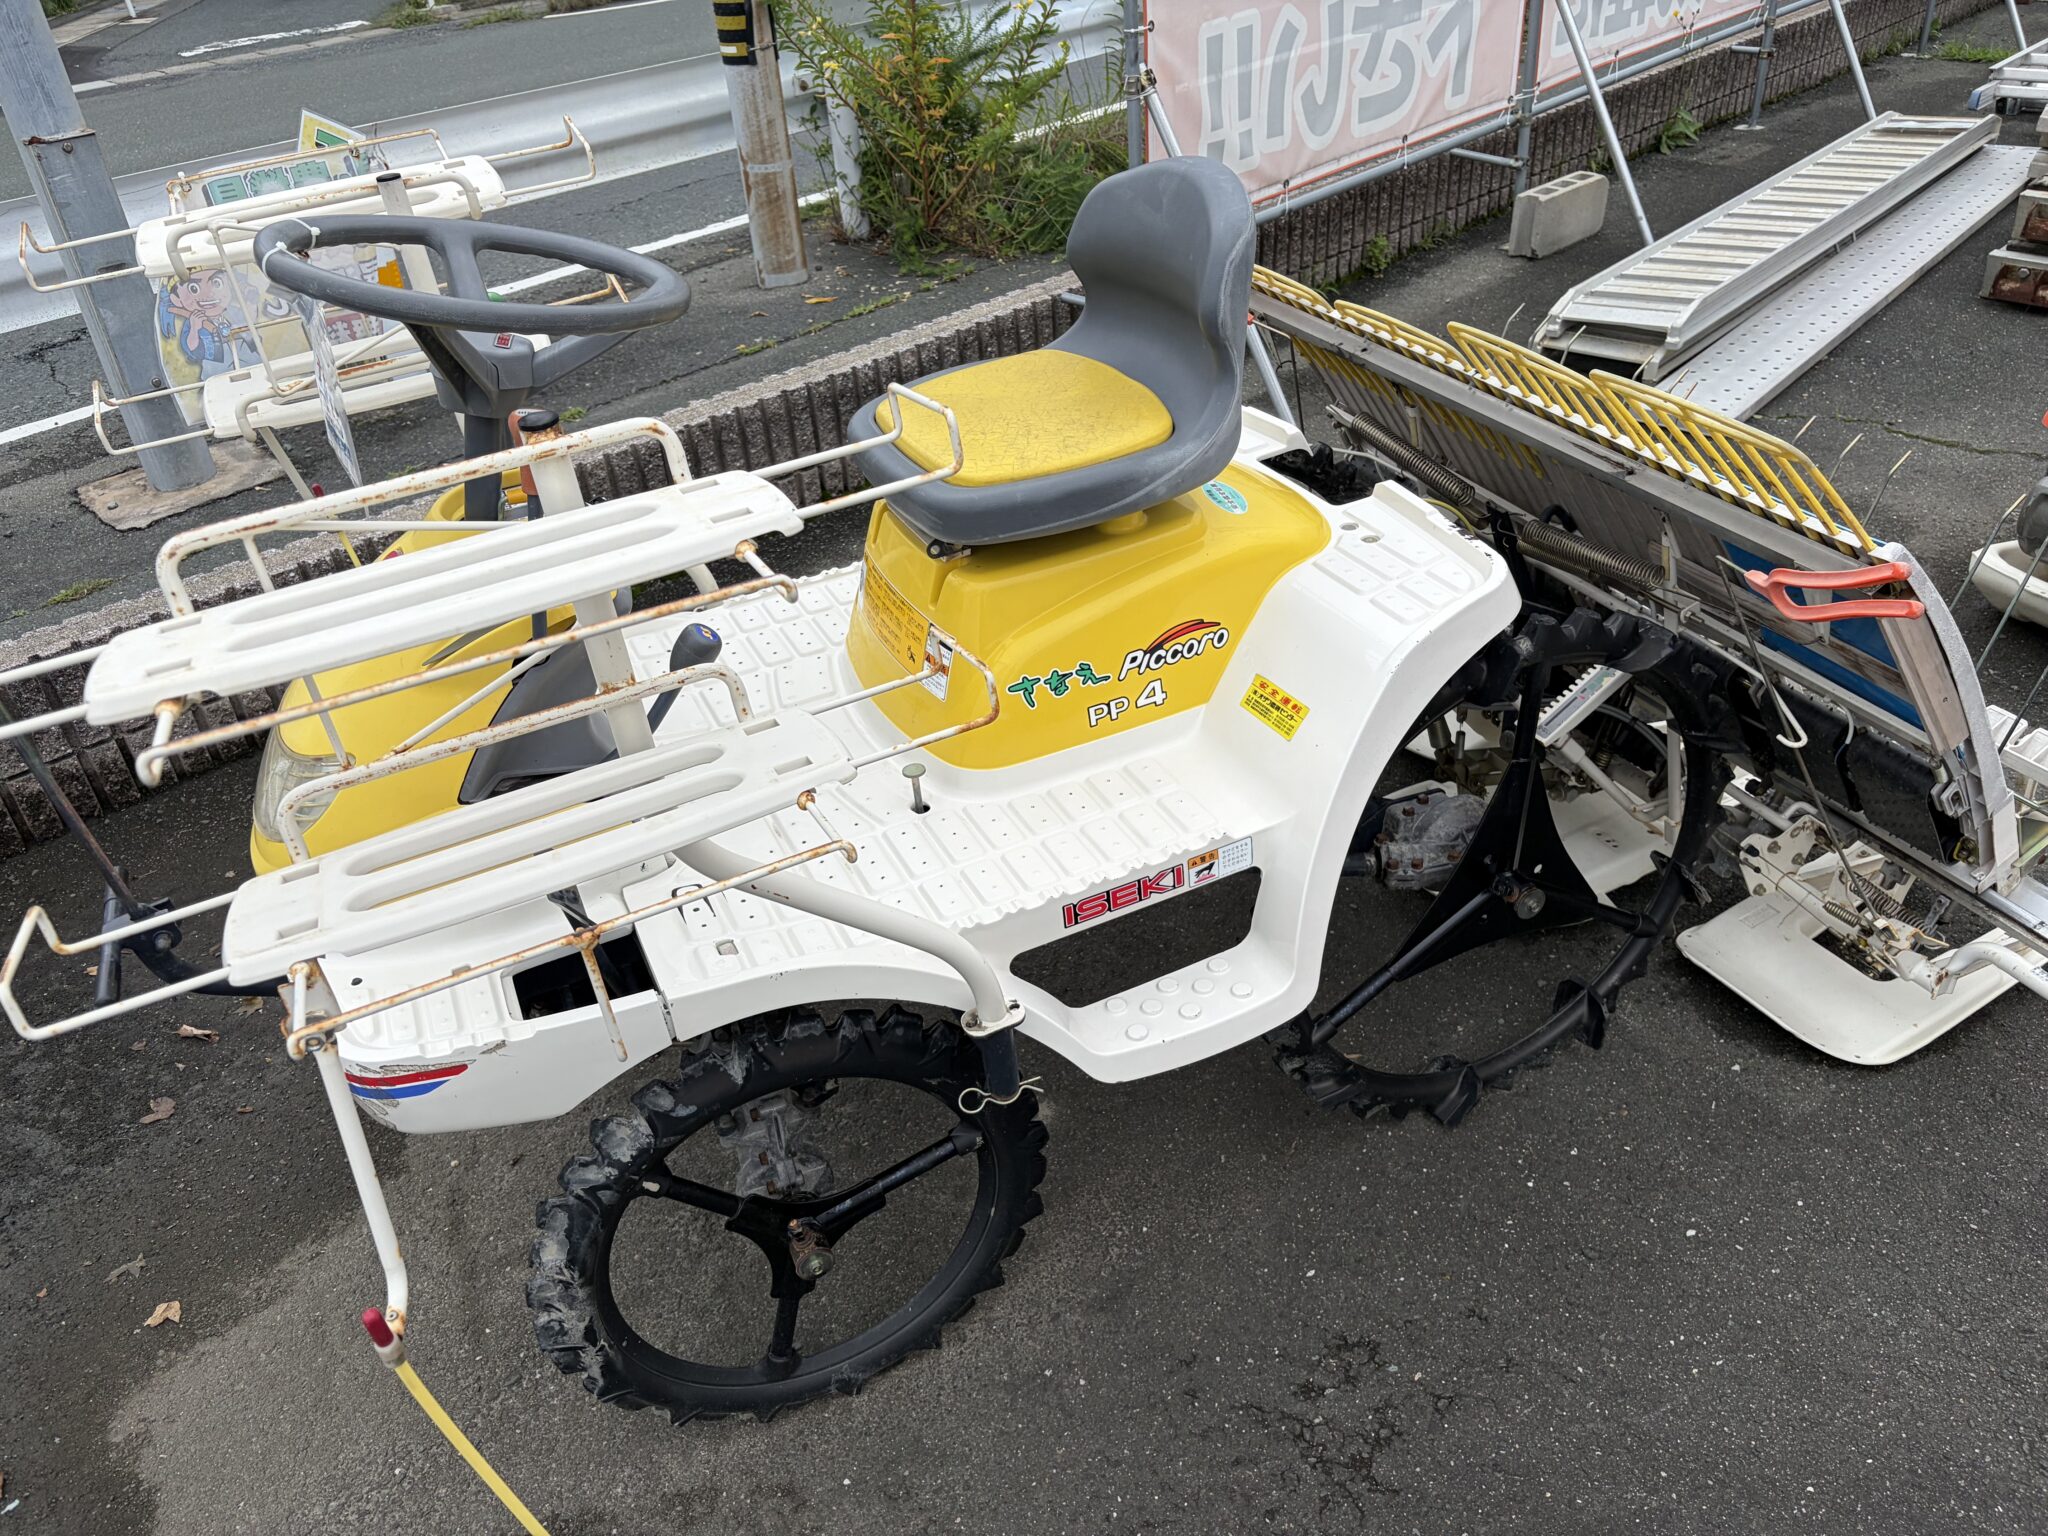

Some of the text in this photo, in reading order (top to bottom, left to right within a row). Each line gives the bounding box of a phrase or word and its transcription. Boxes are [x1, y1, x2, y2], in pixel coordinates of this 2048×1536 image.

[1118, 628, 1229, 681] Piccoro
[1007, 662, 1112, 709] さなえ
[1088, 679, 1167, 727] PP 4
[1063, 864, 1184, 928] ISEKI
